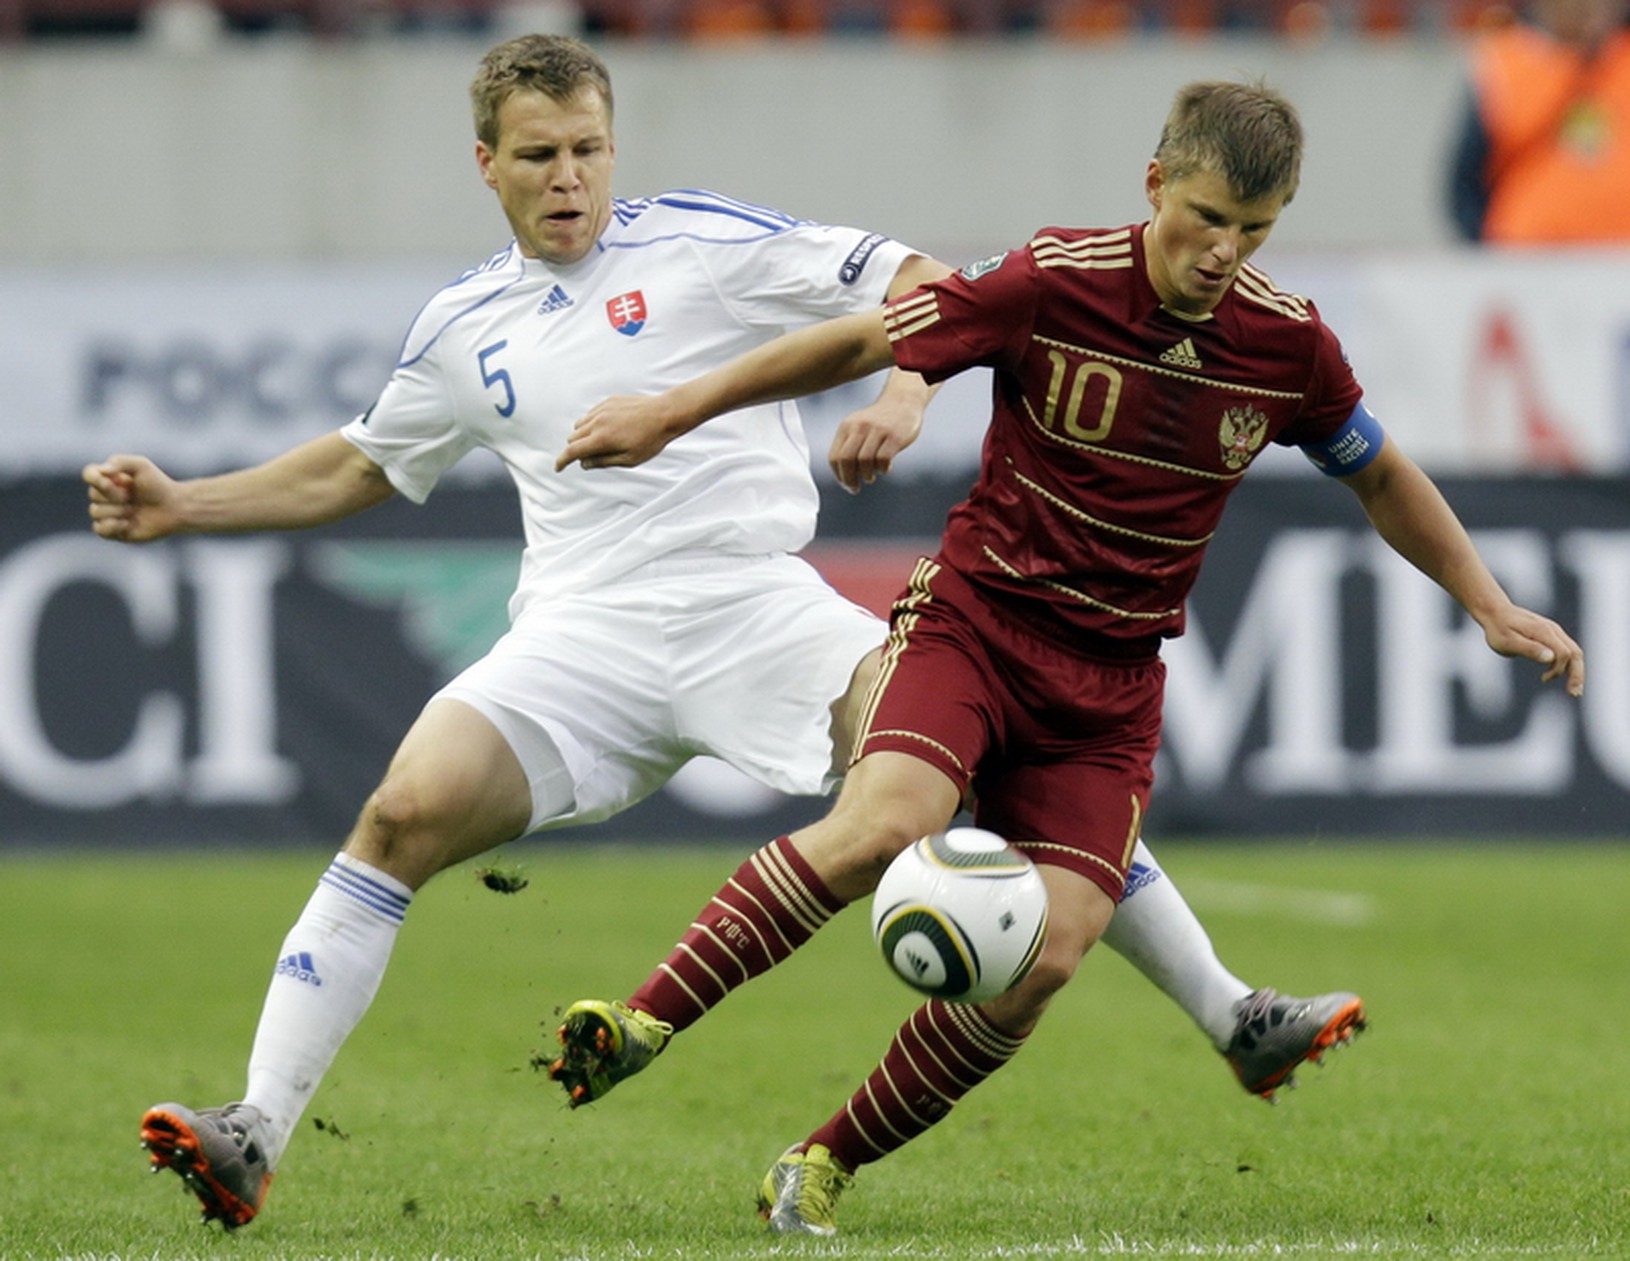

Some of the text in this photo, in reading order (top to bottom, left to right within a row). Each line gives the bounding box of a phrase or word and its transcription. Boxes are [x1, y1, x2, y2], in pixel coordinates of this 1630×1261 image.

[477, 339, 516, 418] 5
[1159, 352, 1203, 370] adidas
[1043, 349, 1123, 441] 10
[1327, 427, 1360, 454] UNITE
